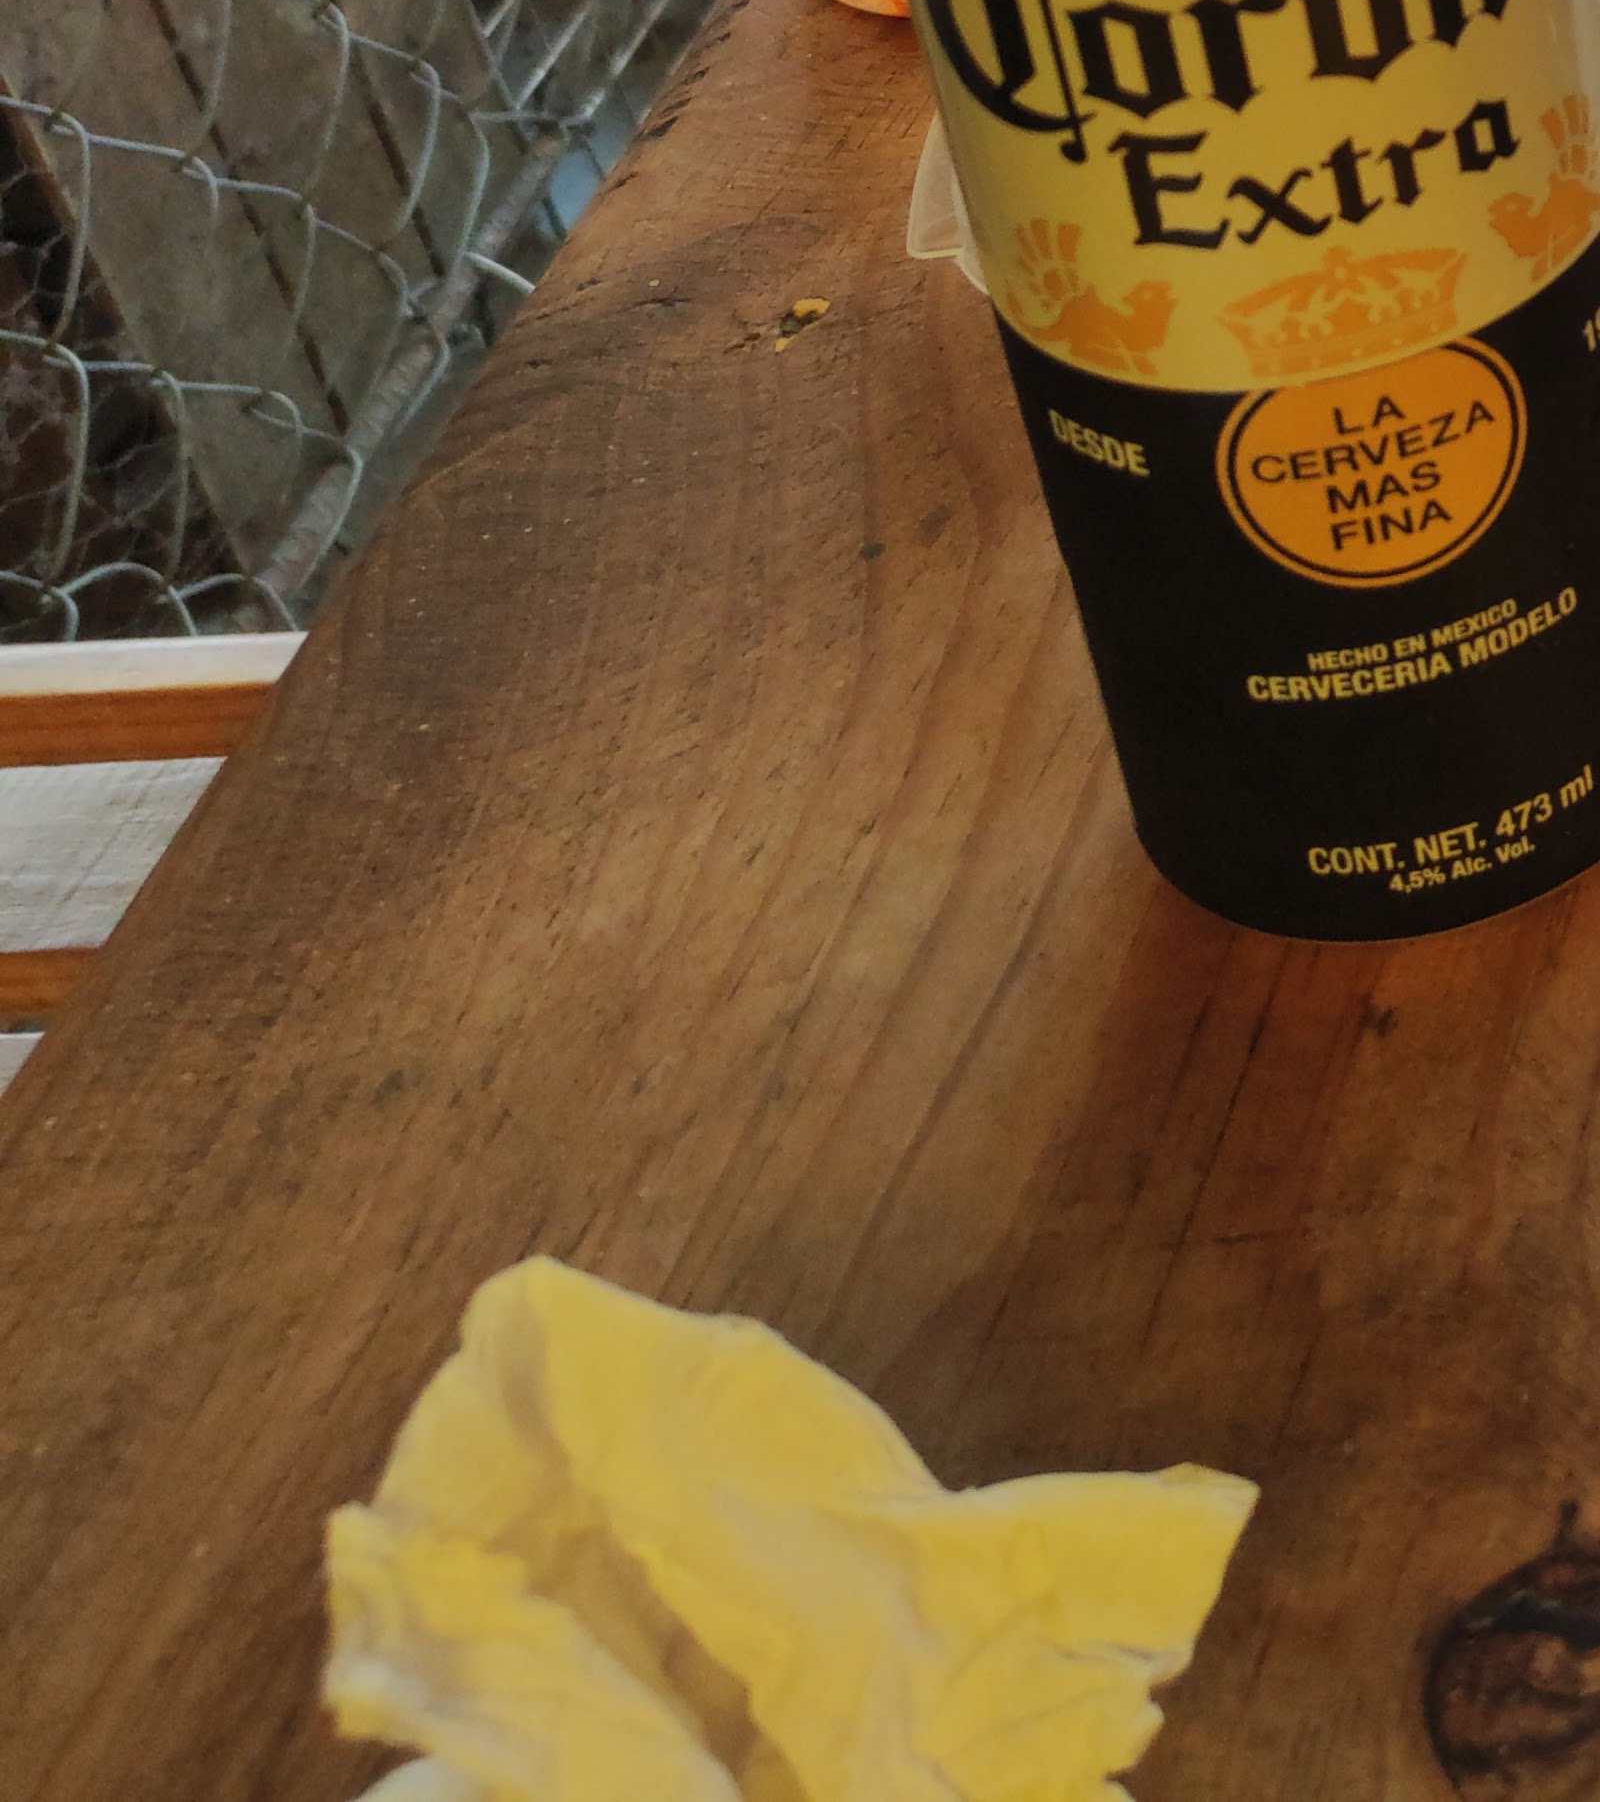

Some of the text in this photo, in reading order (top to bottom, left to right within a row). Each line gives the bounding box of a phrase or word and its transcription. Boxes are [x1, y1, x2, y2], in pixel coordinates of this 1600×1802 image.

[1108, 98, 1523, 251] Extra
[1048, 408, 1151, 478] DESDE
[1251, 399, 1498, 485] CERVEZA
[1332, 396, 1406, 435] LA
[1325, 460, 1443, 515] MAS
[1330, 498, 1454, 552] FINA
[1247, 586, 1578, 701] CERVECERIA MODELO
[1308, 598, 1518, 671] HECHO EN MEXICO
[1308, 765, 1595, 877] CONT. NET. 473 ml
[1450, 851, 1493, 880] Alc.
[1495, 835, 1536, 864] Vol.
